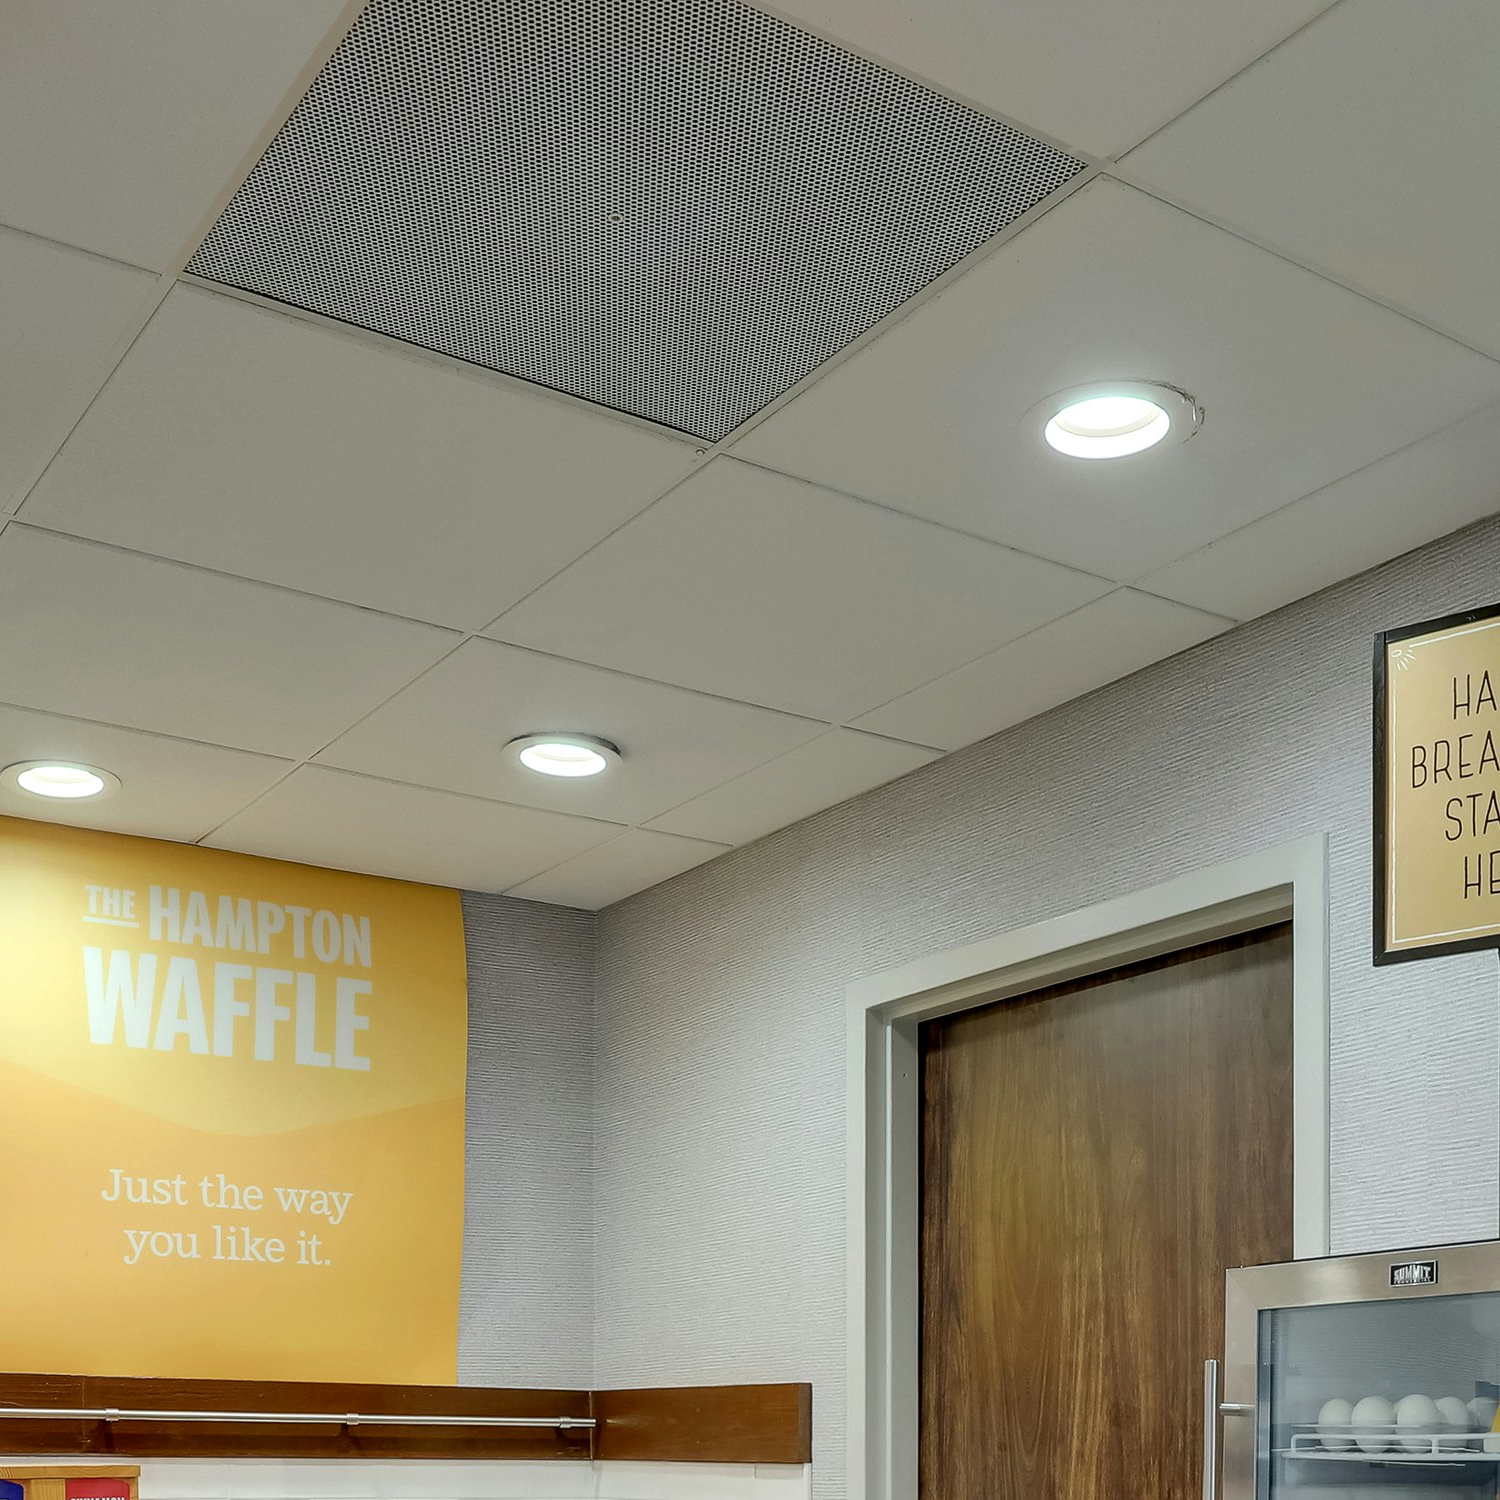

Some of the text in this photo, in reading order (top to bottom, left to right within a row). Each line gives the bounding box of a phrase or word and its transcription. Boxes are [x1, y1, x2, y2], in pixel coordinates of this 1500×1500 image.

[85, 884, 372, 968] THE HAMPTON
[82, 946, 372, 1072] WAFFLE
[101, 1168, 353, 1225] Just the way
[123, 1225, 332, 1266] you like it.
[1394, 1264, 1431, 1280] SUMMIT
